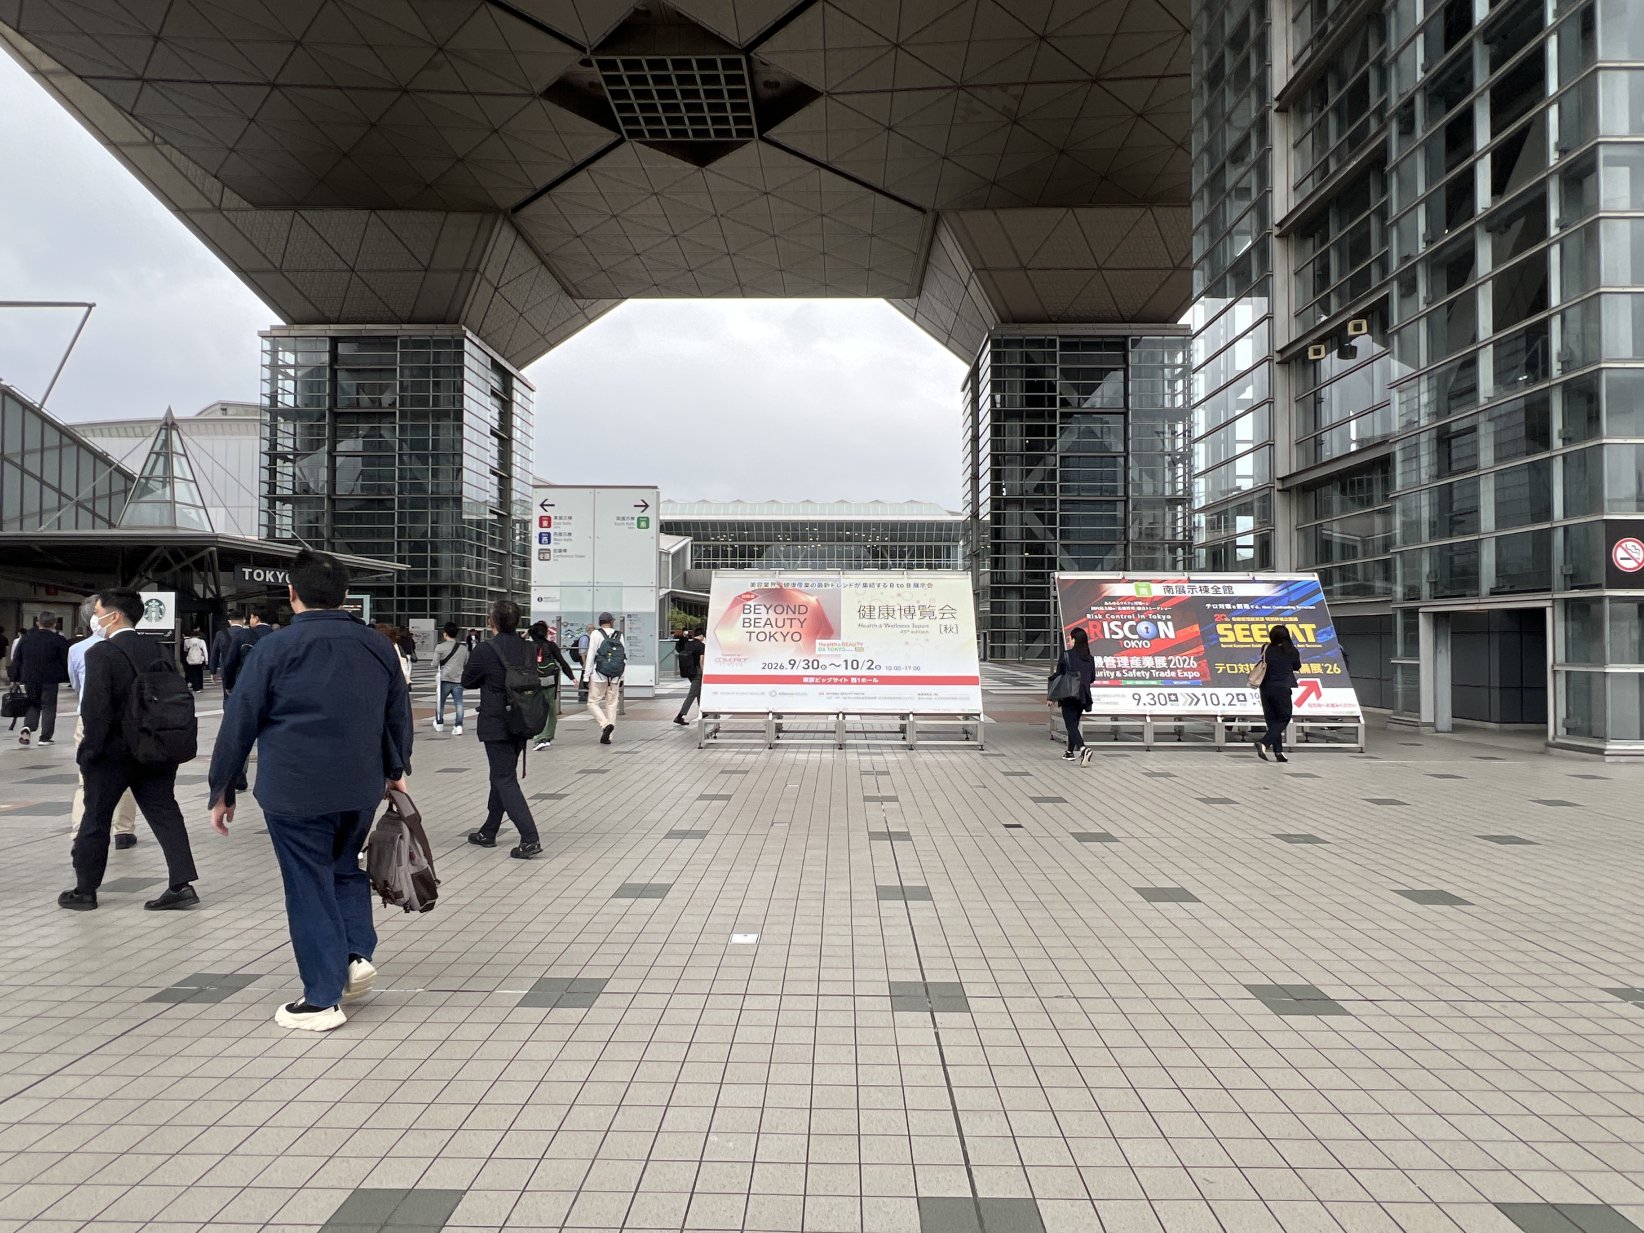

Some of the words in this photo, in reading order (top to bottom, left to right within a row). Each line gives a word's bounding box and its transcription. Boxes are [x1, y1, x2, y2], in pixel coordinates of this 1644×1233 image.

[242, 567, 290, 584] TOKY
[1162, 584, 1235, 595] 南展示棟全館
[742, 604, 809, 615] BEYOND
[857, 604, 958, 620] 健康博覧会
[1147, 613, 1172, 621] Tokyo
[742, 618, 807, 629] BEAUTY
[745, 631, 802, 642] TOKYO
[1216, 623, 1317, 643] SEEAT
[1121, 669, 1150, 679] Safety
[1150, 669, 1176, 678] Trade
[1177, 669, 1201, 679] Expo
